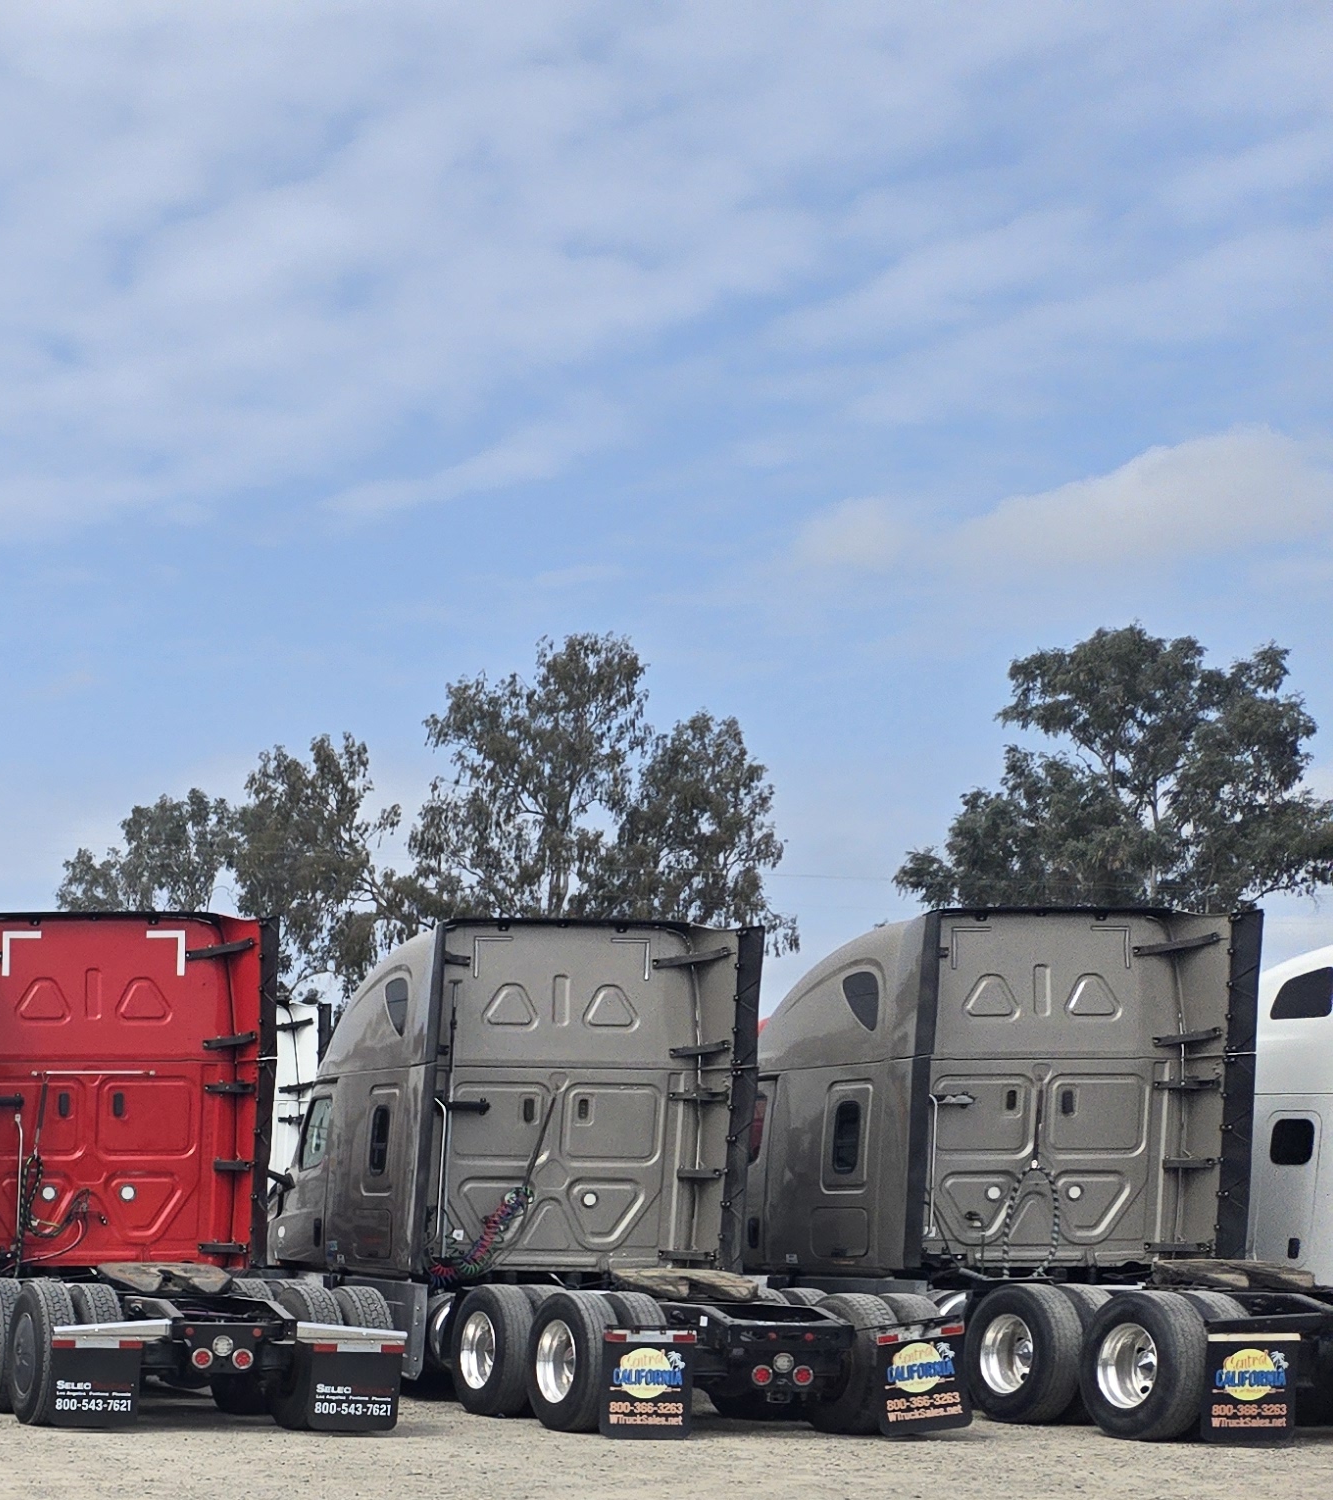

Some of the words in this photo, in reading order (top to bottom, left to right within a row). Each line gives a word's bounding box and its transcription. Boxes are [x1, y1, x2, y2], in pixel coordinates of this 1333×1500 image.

[620, 1348, 666, 1369] Central
[892, 1341, 935, 1366] Central
[1223, 1349, 1269, 1370] Central
[613, 1367, 683, 1385] CALIFORNIA
[887, 1358, 955, 1382] CALIFORNIA
[1215, 1369, 1286, 1387] CALIFORNIA
[55, 1398, 131, 1411] 800-543-7621
[314, 1402, 391, 1416] 800-543-7621
[609, 1402, 684, 1414] 800-366-3263
[886, 1391, 961, 1411] 800-366-3263
[1211, 1404, 1287, 1416] 800-366-3263
[609, 1414, 683, 1425] WTruckSales.net
[887, 1404, 963, 1422] WTruckSales.net
[1211, 1417, 1287, 1427] WTruckSales.net
